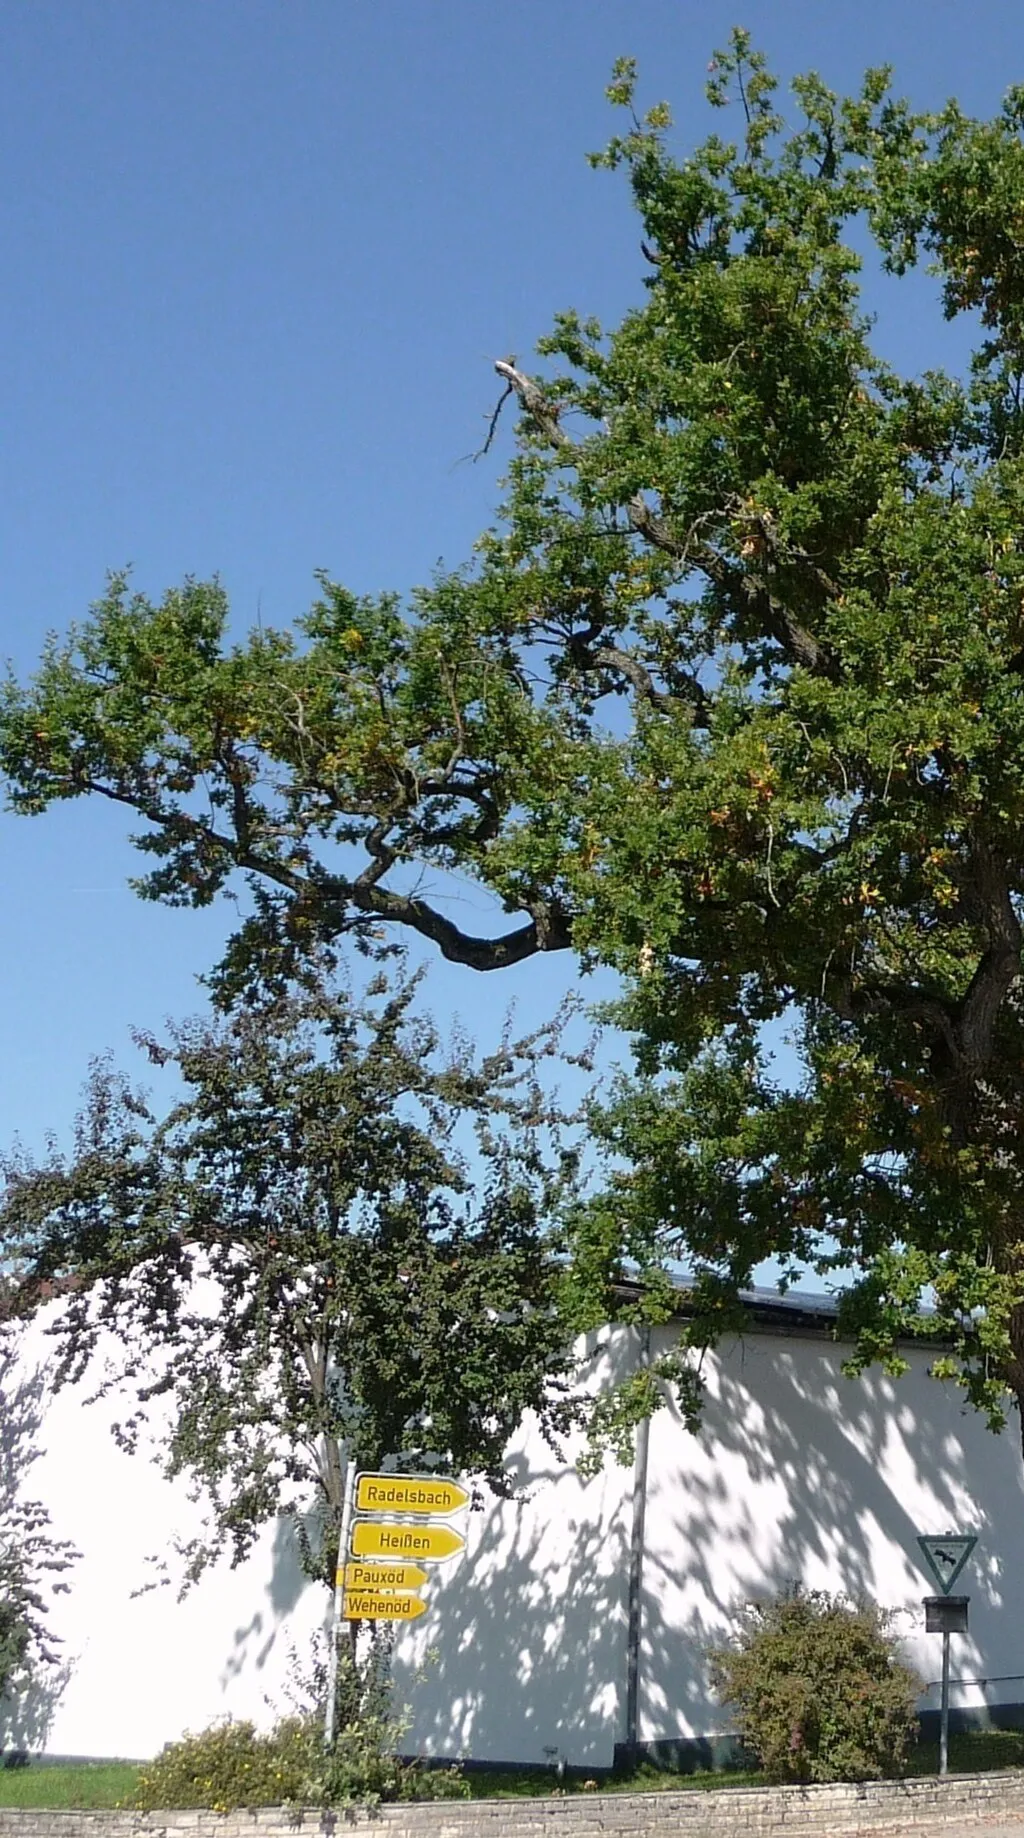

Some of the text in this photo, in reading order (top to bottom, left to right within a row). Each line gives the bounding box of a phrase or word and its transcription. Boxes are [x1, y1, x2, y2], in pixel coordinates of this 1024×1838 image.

[368, 1487, 451, 1505] Radelsbach
[380, 1533, 430, 1549] Heißen
[354, 1568, 405, 1583] Pauxöd
[348, 1597, 411, 1613] Wehenöd
